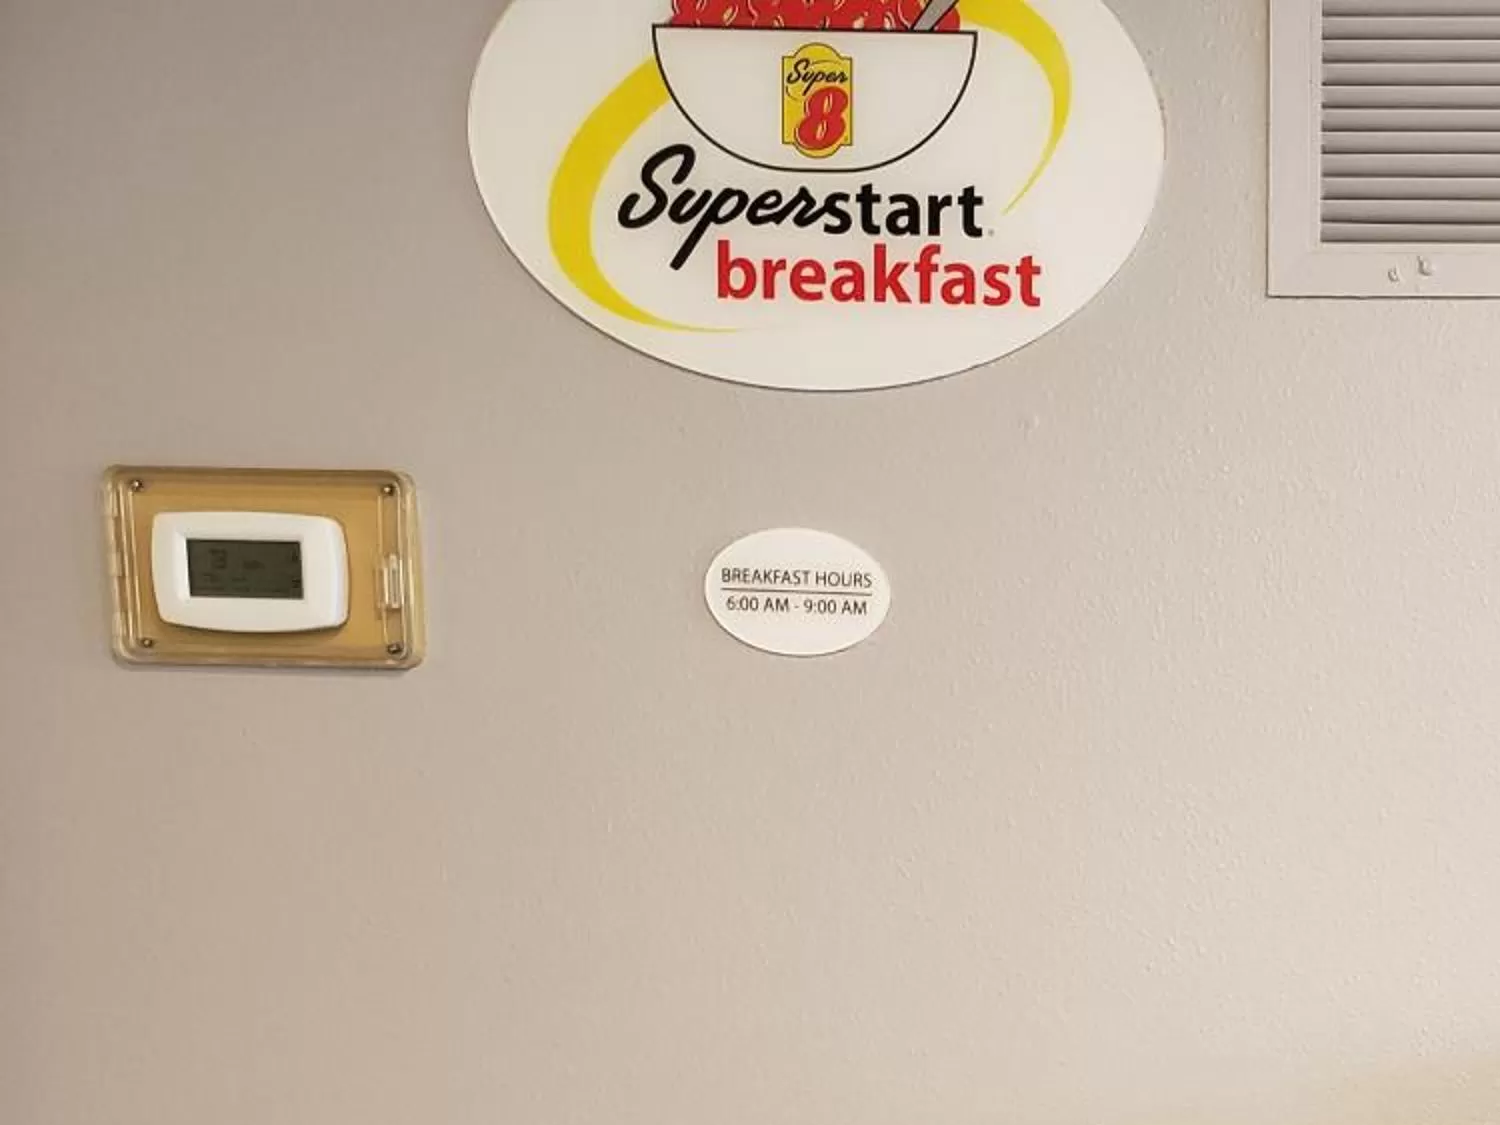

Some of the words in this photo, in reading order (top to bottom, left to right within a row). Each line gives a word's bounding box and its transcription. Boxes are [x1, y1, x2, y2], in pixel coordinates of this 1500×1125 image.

[786, 58, 848, 97] Super
[794, 86, 849, 151] 8
[618, 143, 983, 271] Superstart
[716, 240, 1041, 307] breakfast
[721, 567, 811, 586] BREAKFAST
[815, 571, 873, 588] HOURS
[726, 596, 759, 612] 6:00
[763, 597, 790, 612] AM
[803, 599, 837, 615] 9:00
[841, 600, 867, 615] AM
